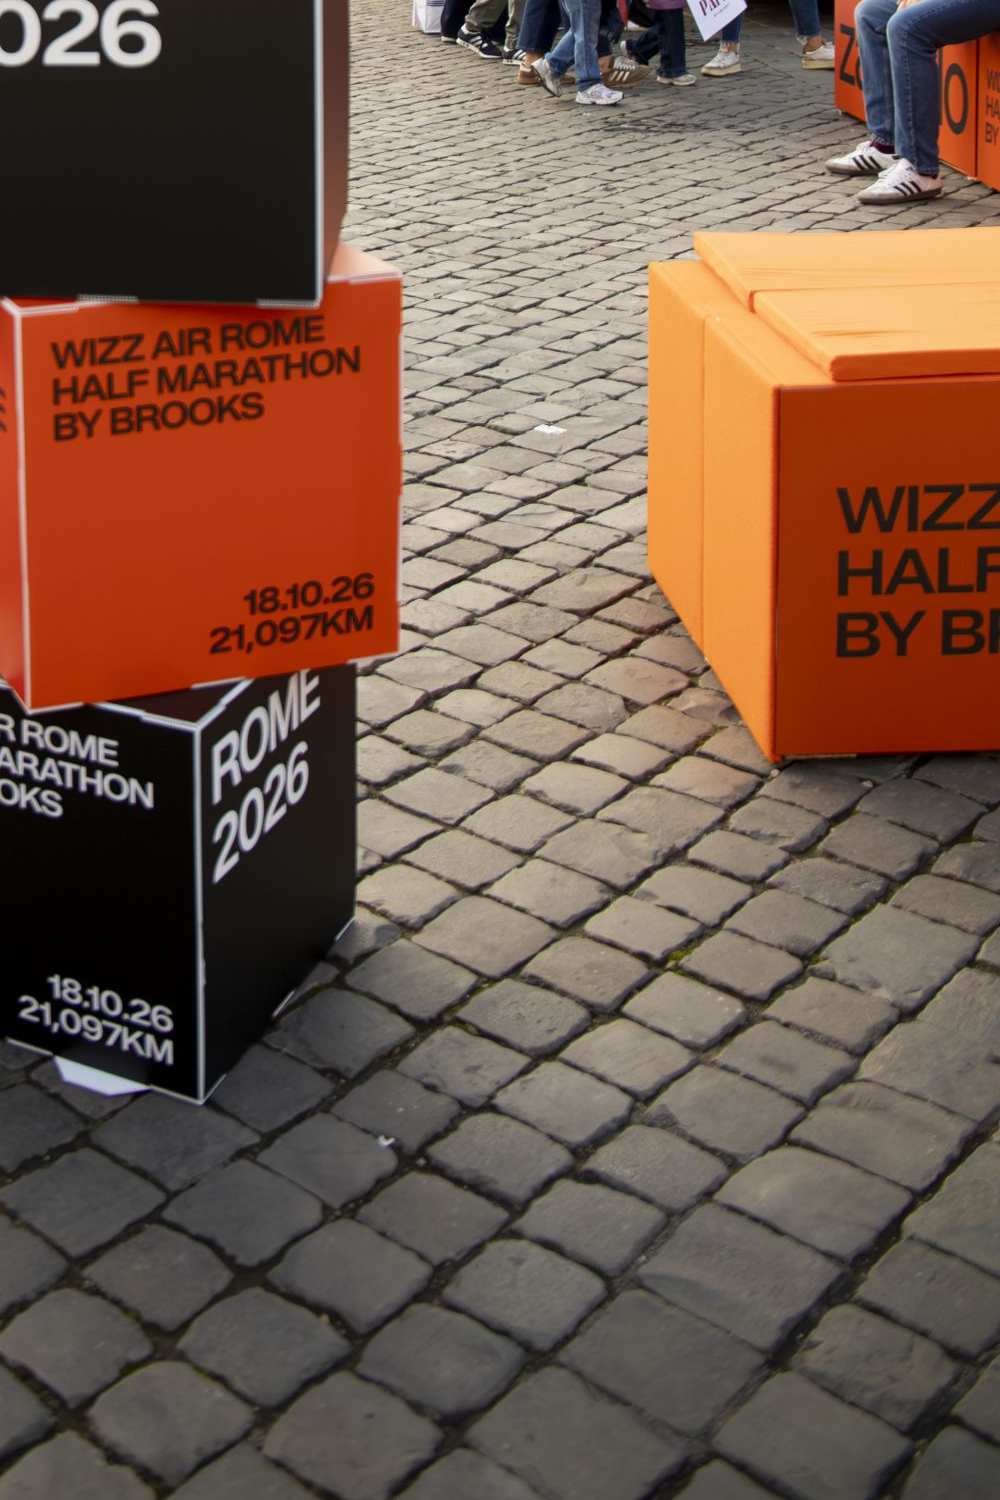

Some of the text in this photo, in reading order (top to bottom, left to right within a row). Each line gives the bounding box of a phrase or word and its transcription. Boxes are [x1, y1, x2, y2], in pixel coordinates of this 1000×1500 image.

[51, 315, 325, 369] WIZZ AIR ROME
[52, 346, 361, 405] HALF MARATHON
[54, 392, 265, 442] BY BROOKS
[836, 483, 1000, 534] WIZZ
[244, 573, 375, 616] 18.10.26
[837, 545, 1000, 596] HALF
[209, 605, 373, 655] 21,097KM
[836, 610, 927, 658] BY
[21, 718, 119, 767] ROME
[211, 668, 321, 806] ROME
[212, 741, 309, 885] 2026
[47, 974, 174, 1033] 18.10.26
[18, 995, 174, 1066] 21,097KM
